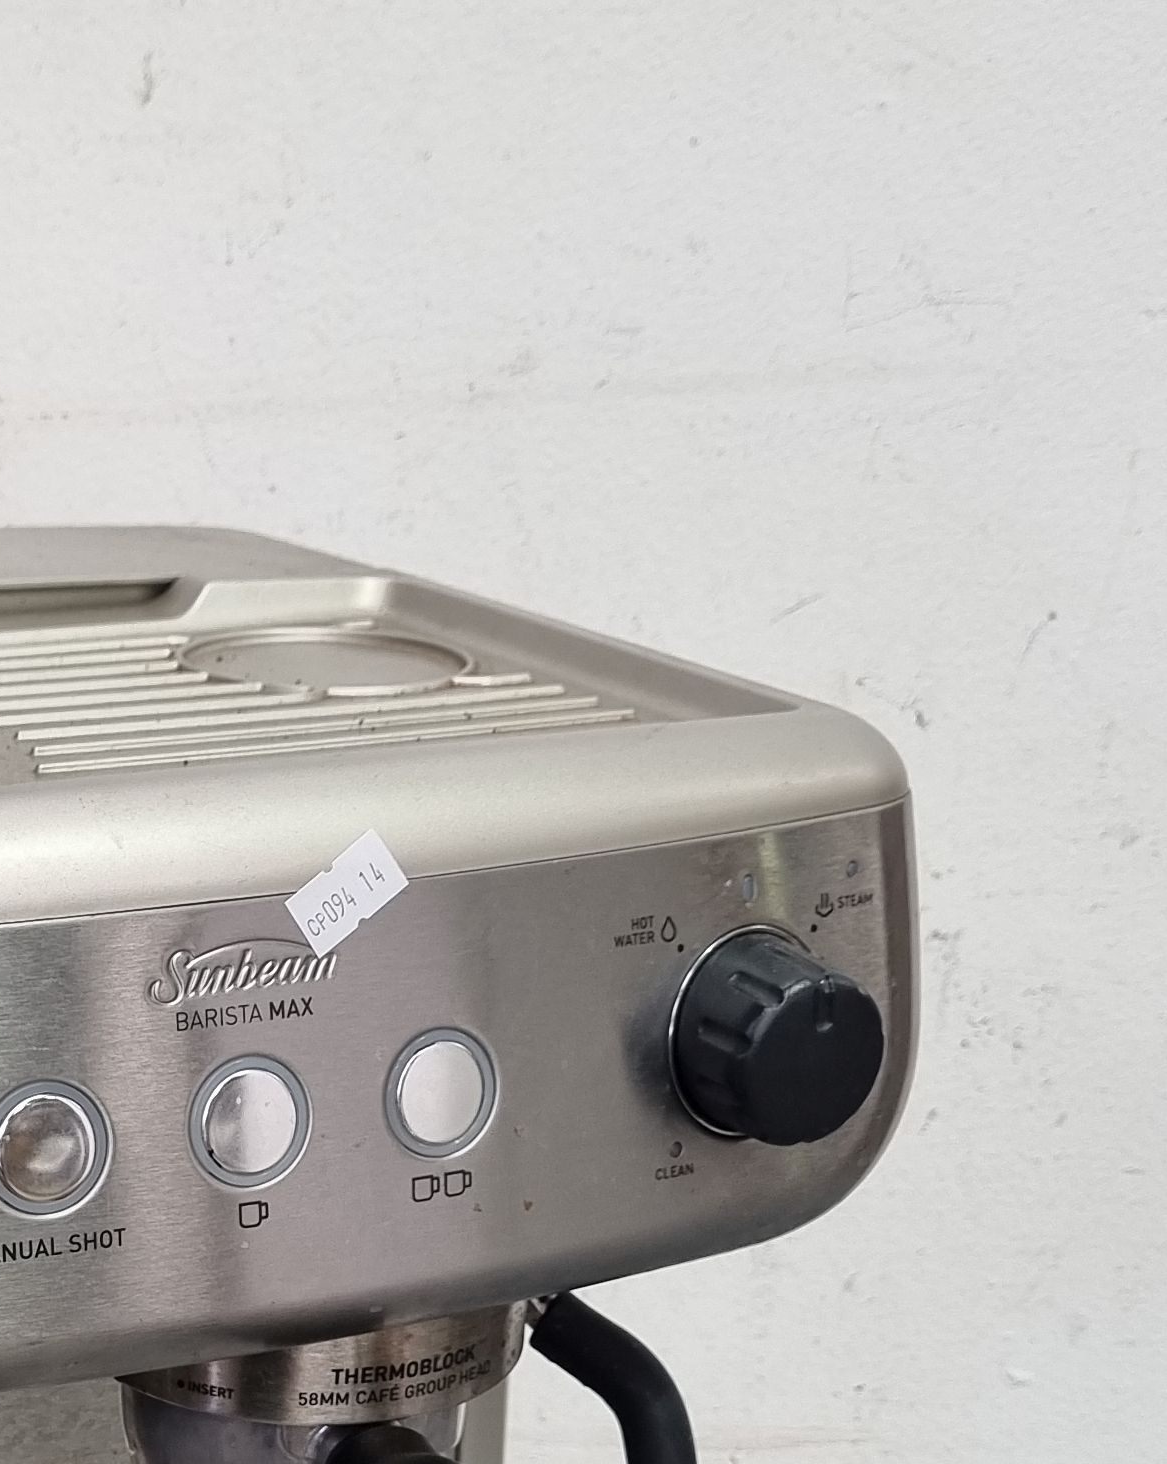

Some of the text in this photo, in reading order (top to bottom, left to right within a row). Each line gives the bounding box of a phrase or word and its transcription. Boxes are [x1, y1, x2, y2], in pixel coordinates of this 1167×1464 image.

[306, 863, 386, 937] CP094 14
[836, 893, 875, 910] STEAM
[631, 915, 655, 930] HOT
[614, 931, 655, 948] WATER
[148, 938, 337, 1006] Sunbeam
[176, 996, 314, 1032] BARISTA MAX
[654, 1163, 695, 1181] CLEAN
[68, 1228, 127, 1253] SHOT
[332, 1344, 477, 1385] THERMOBLOCK
[187, 1381, 235, 1400] INSERT
[298, 1359, 492, 1407] 58MM CAFÉ GROUP HEAD
